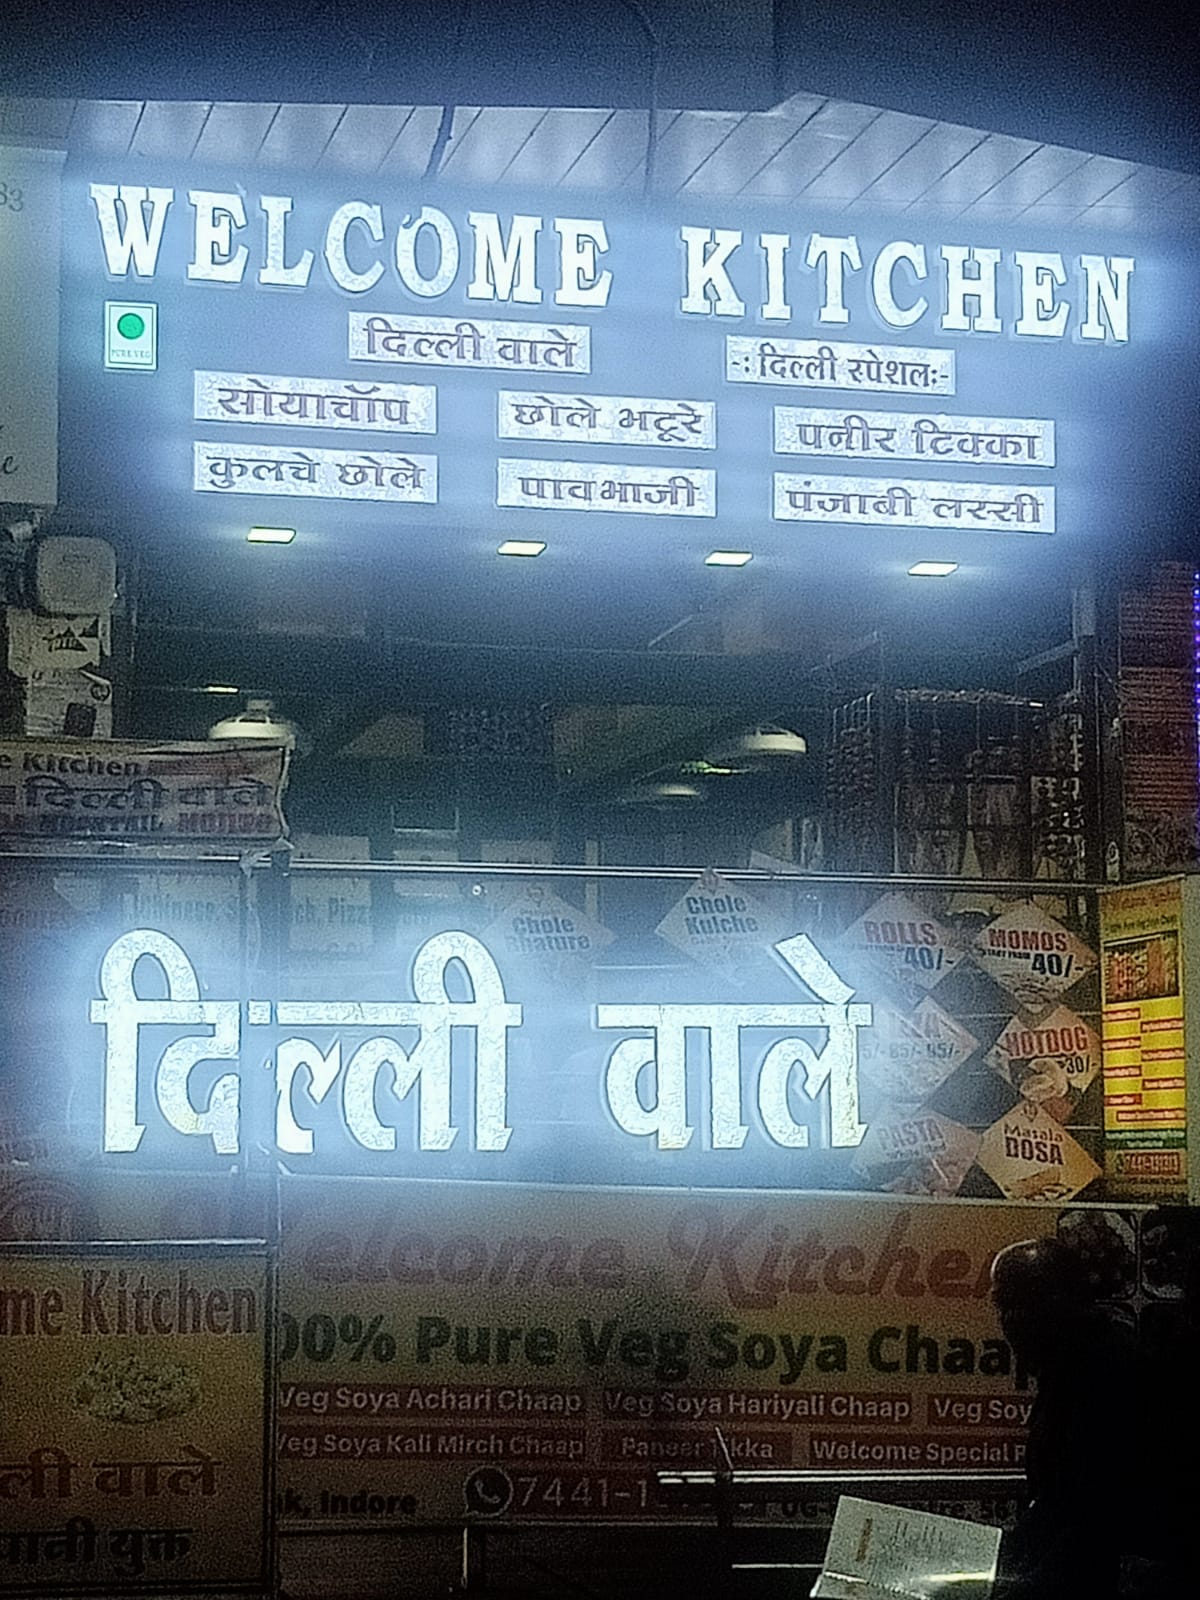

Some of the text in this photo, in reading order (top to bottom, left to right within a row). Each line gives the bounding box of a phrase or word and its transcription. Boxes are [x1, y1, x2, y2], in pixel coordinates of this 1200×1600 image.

[89, 182, 1135, 342] WELCOME KITCHEN
[363, 317, 579, 369] दिल्ली वाले
[757, 342, 837, 381] दिल्ली
[216, 378, 412, 426] सोयाचॉप
[513, 396, 703, 443] छोले भटूरे
[795, 415, 1043, 461] पनीर टिक्का
[207, 451, 426, 491] कुलचे छोले
[785, 481, 1045, 525] पंजाबी लस्सी
[684, 893, 748, 915] Chole
[511, 914, 575, 934] Chole
[683, 913, 760, 936] Kulche
[863, 919, 938, 946] ROLLS
[988, 927, 1068, 952] MOMOS
[1030, 952, 1084, 978] 40/-
[90, 927, 874, 1155] दिल्ली वाले
[1005, 1025, 1088, 1059] HOTDOG
[1004, 1121, 1064, 1143] Masala
[1004, 1136, 1064, 1165] DOSA
[80, 1267, 257, 1336] Kitchen
[416, 1316, 558, 1367] Pure
[577, 1318, 692, 1384] Veg
[707, 1320, 848, 1385] Soya
[279, 1386, 583, 1417] Veg Soya Achari Chaap
[662, 1391, 721, 1419] Soya
[728, 1393, 826, 1421] Hariyali
[829, 1396, 911, 1422] Chaap
[934, 1397, 984, 1423] Veg
[323, 1433, 382, 1459] Soya
[386, 1434, 432, 1455] Kali
[437, 1435, 502, 1457] Mirch
[508, 1437, 586, 1461] Chaap
[812, 1440, 922, 1463] Welcome
[925, 1440, 1011, 1466] Special
[92, 1443, 224, 1498] वाले
[320, 1488, 418, 1516] Indore
